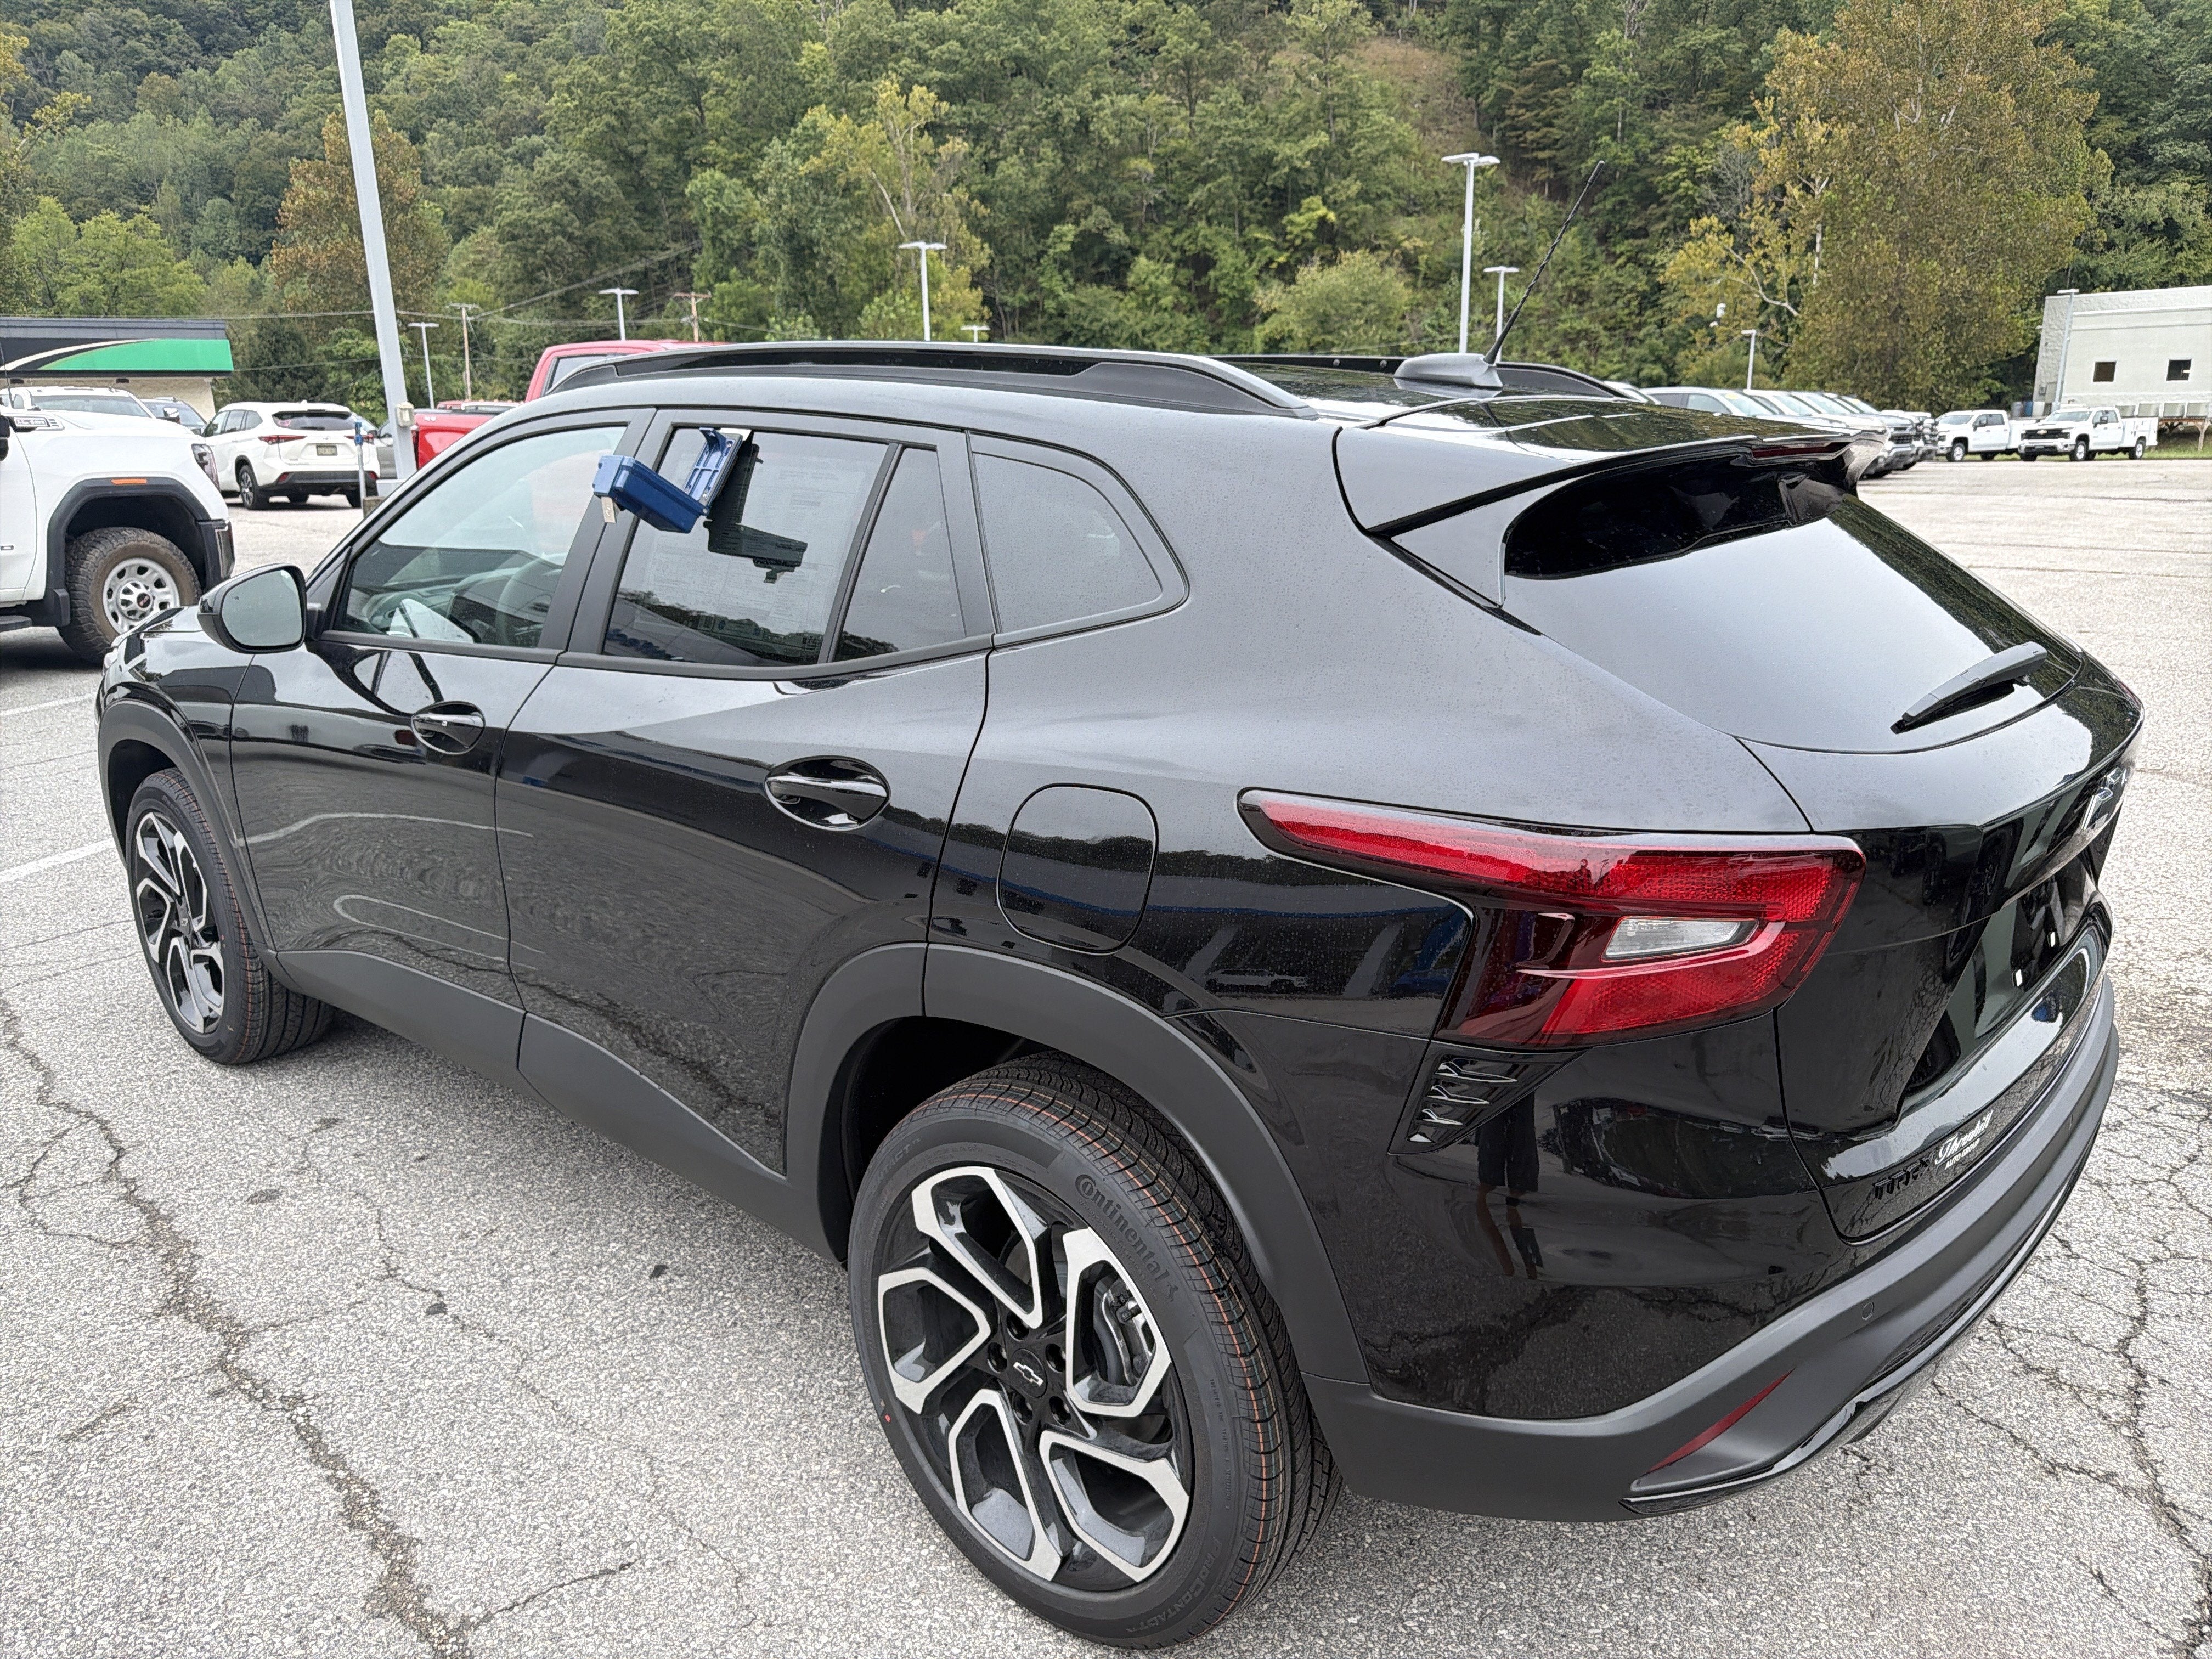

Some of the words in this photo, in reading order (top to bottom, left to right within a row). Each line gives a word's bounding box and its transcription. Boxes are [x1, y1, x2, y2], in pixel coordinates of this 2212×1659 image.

[1944, 1154, 1961, 1170] AUTO
[1961, 1138, 1980, 1158] GROUP
[1075, 1173, 1170, 1281] Continental
